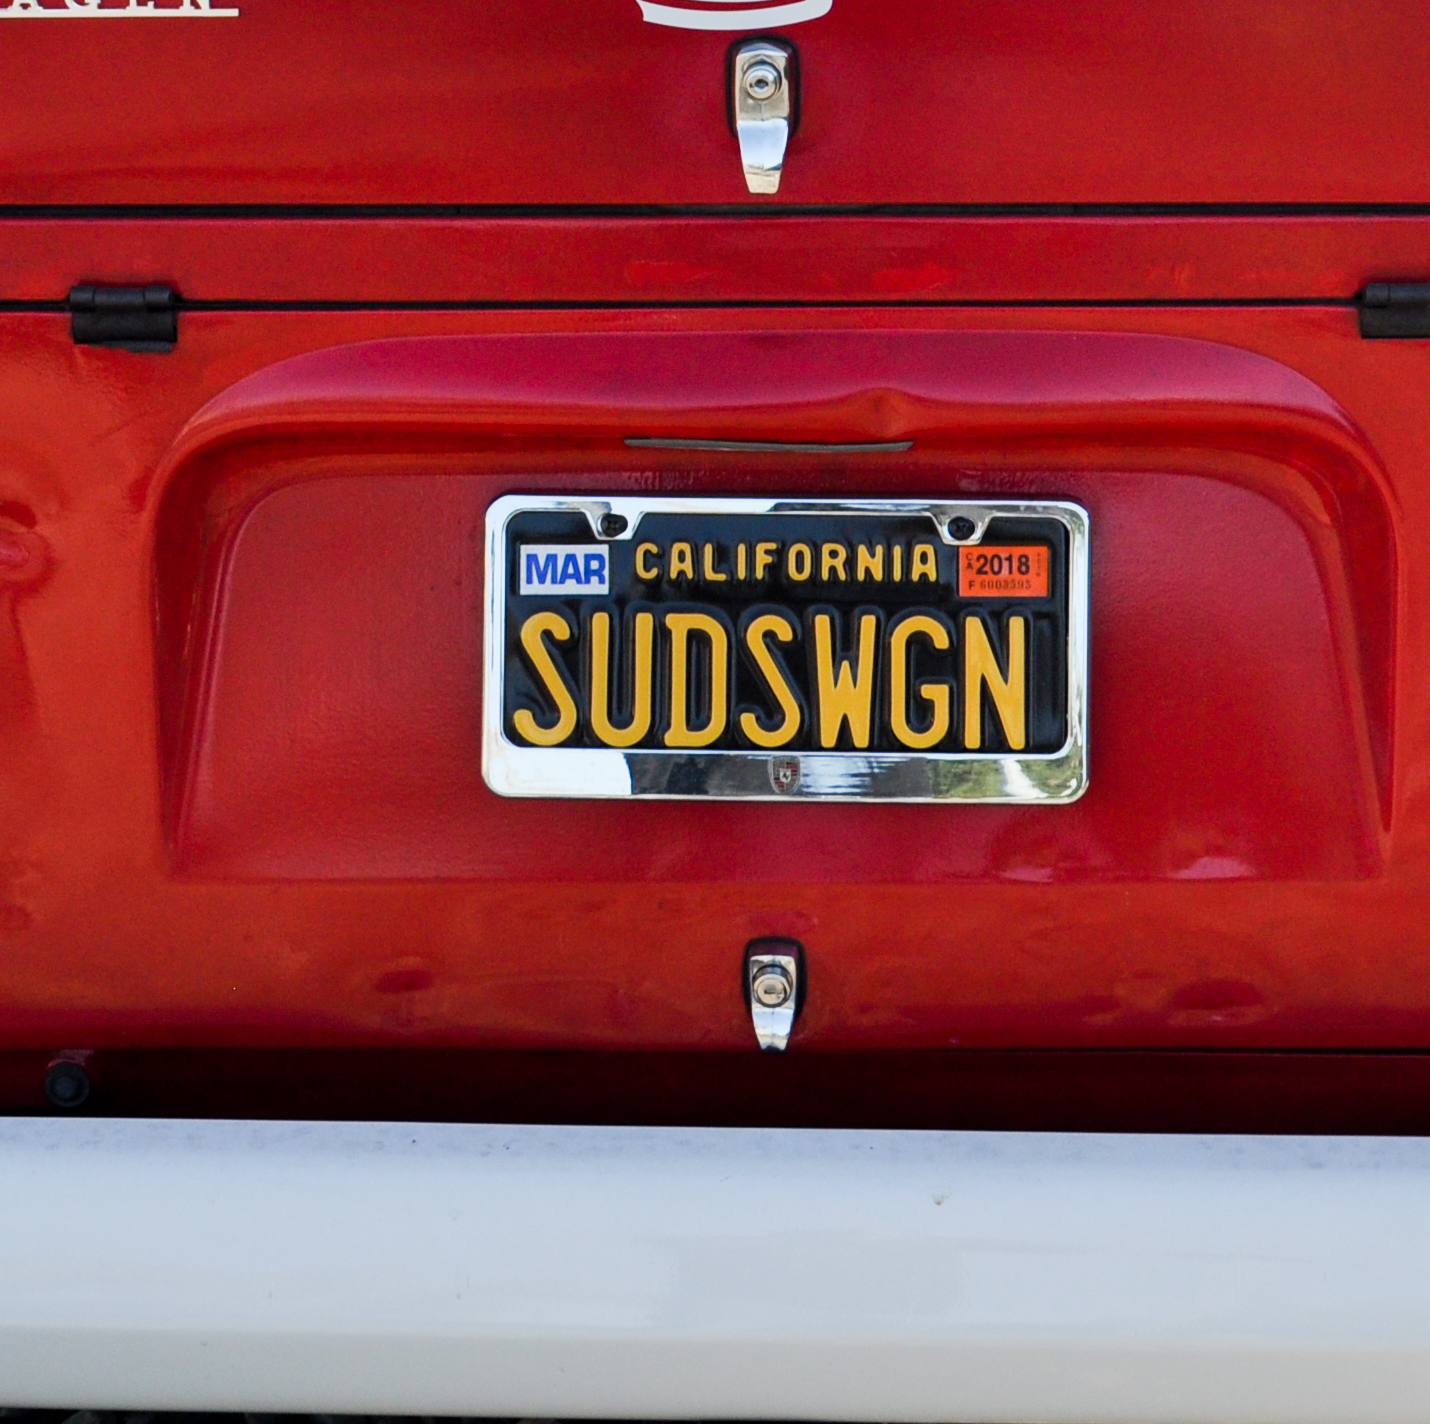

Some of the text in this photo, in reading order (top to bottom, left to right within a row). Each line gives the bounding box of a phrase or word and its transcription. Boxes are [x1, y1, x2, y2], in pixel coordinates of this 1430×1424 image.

[525, 553, 607, 585] MAR
[635, 542, 938, 583] CALIFORNIA
[975, 553, 1030, 575] 2018
[513, 611, 1027, 750] SUDSWGN
